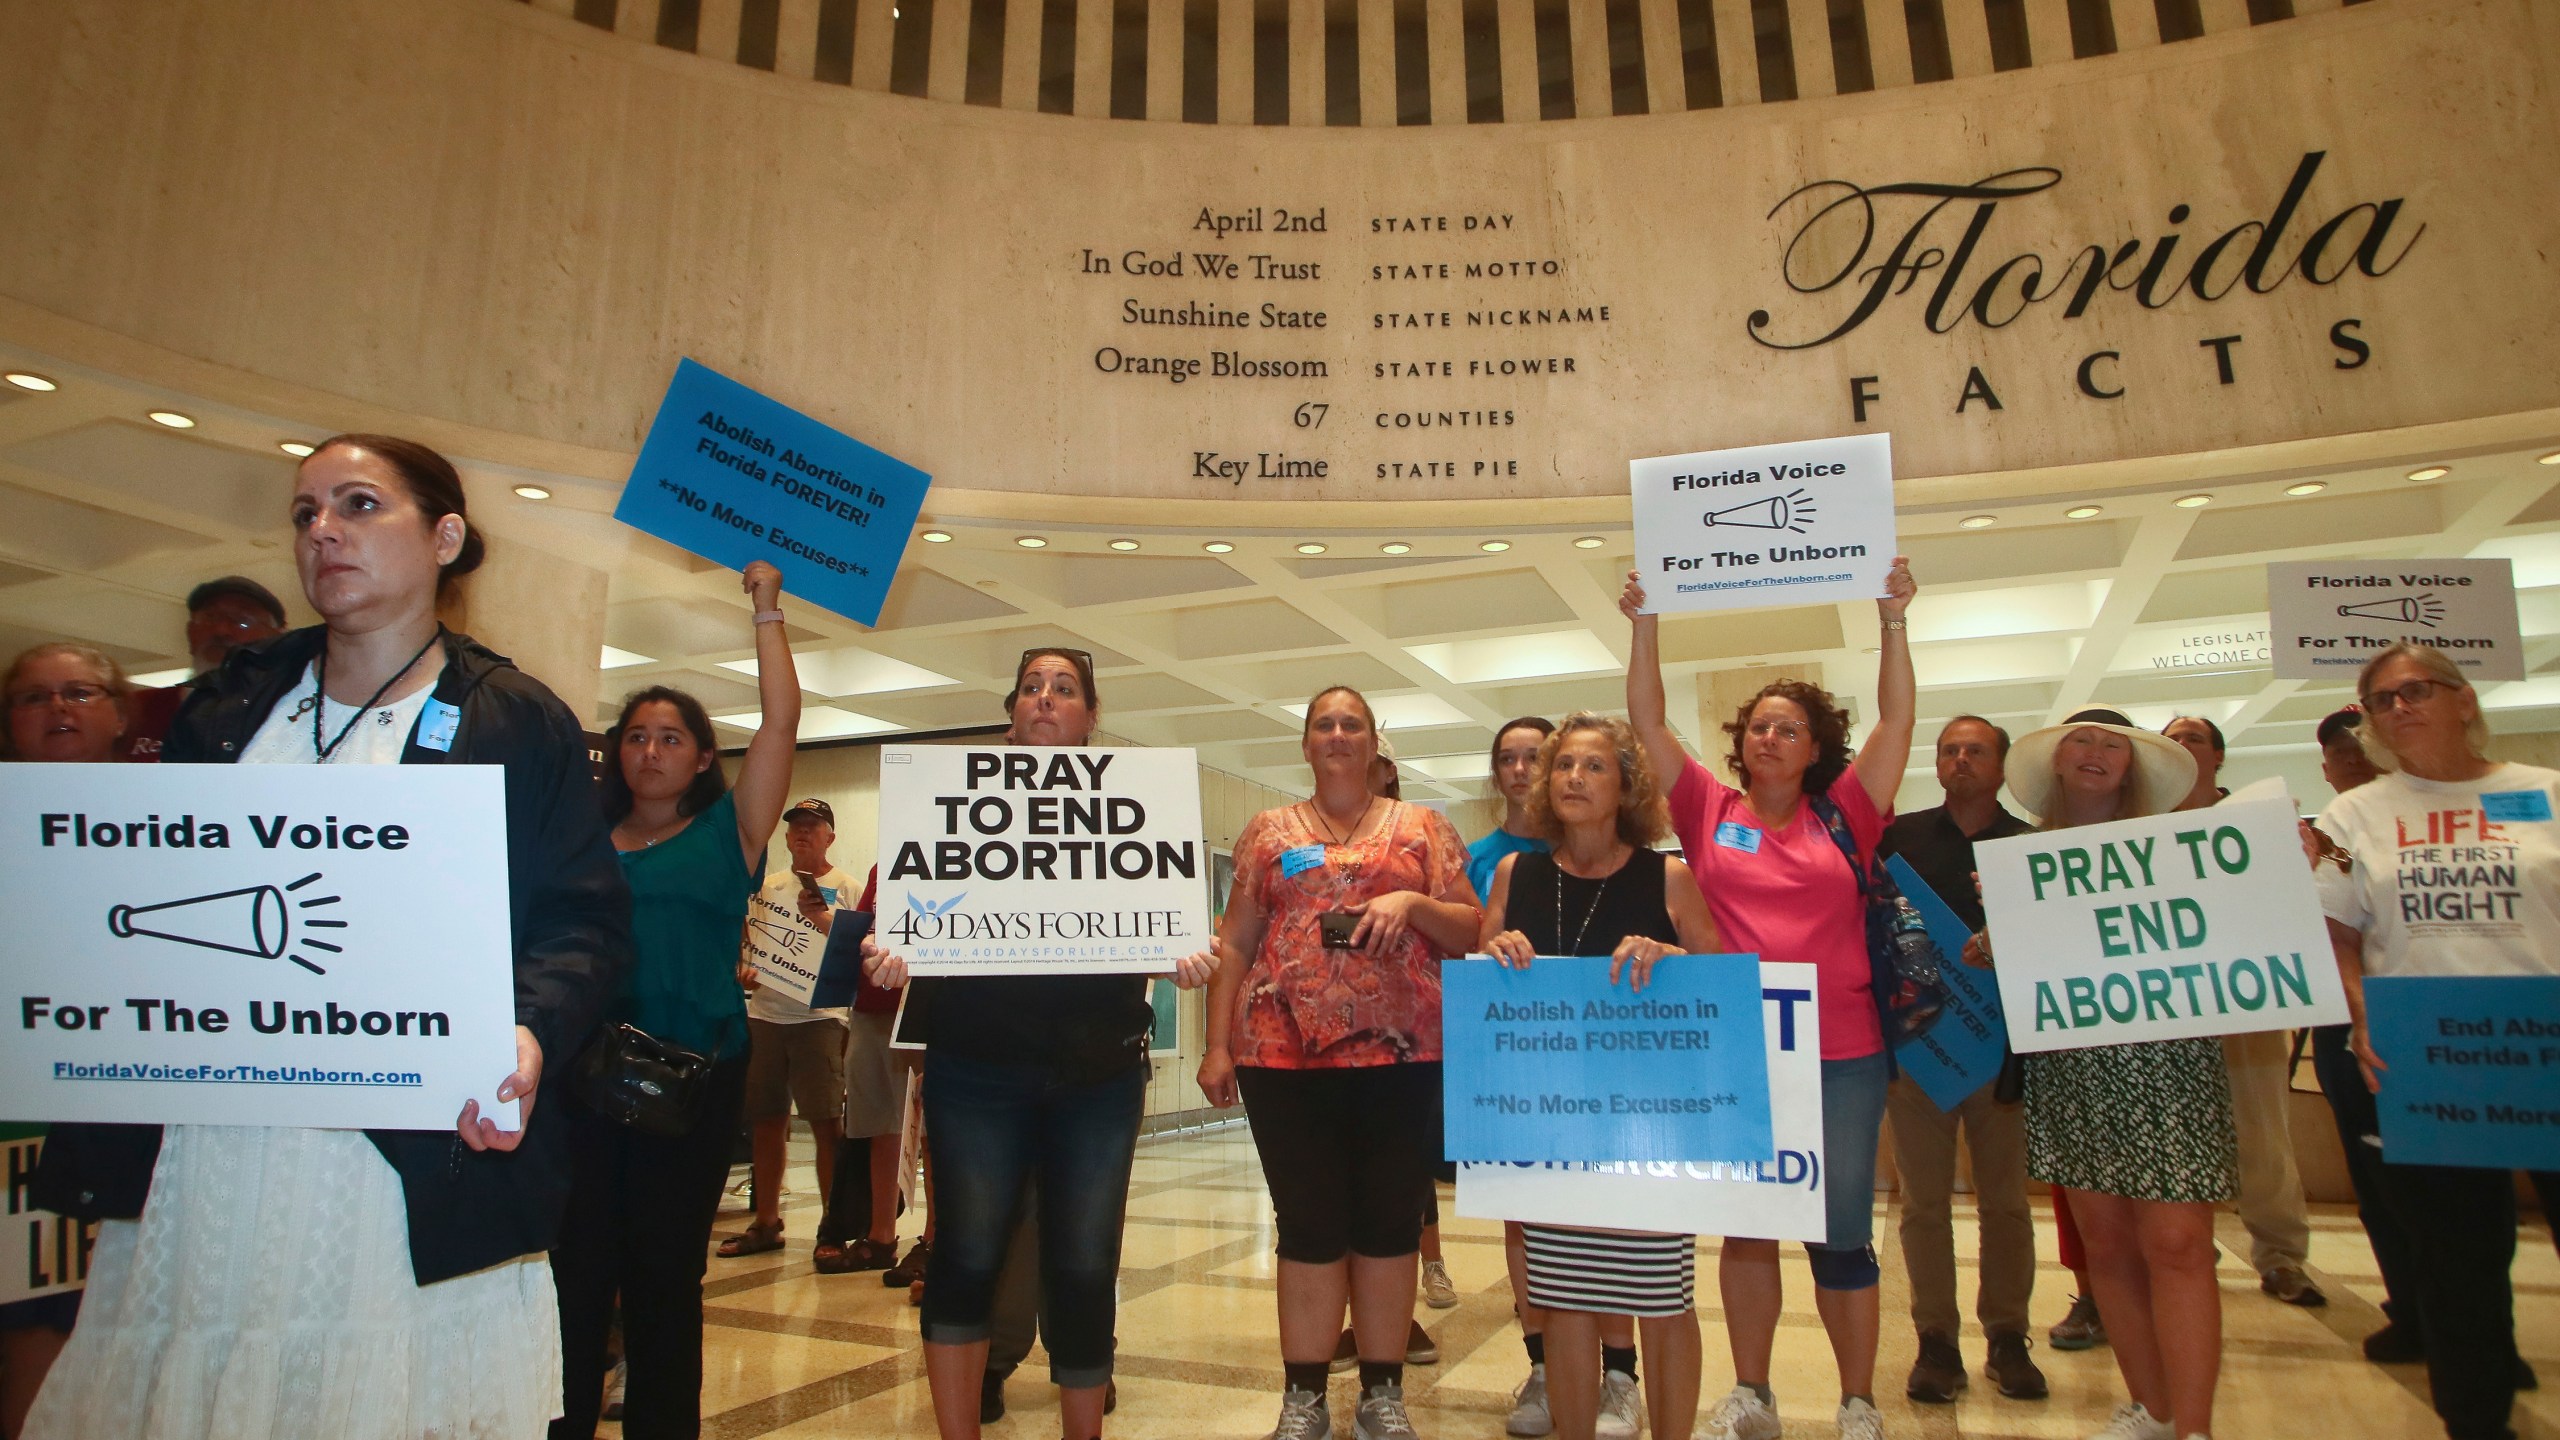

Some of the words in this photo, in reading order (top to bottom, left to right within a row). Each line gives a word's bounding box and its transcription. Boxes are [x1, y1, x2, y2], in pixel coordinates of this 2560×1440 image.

[1193, 207, 1264, 239] April
[1273, 207, 1327, 233] 2nd
[1372, 217, 1448, 232] STATE
[1465, 214, 1514, 230] DAY
[1747, 150, 2426, 349] Florida
[1082, 250, 1111, 274] In
[1121, 251, 1183, 277] God
[1193, 253, 1239, 280] We
[1248, 255, 1320, 281] Trust
[1373, 264, 1449, 280] STATE
[1466, 260, 1559, 277] MOTTO
[1122, 299, 1249, 328] Sunshine
[1260, 306, 1327, 328] State
[1374, 313, 1451, 328] STATE
[1468, 307, 1610, 326] NICKNAME
[1095, 348, 1200, 382] Orange
[1212, 352, 1328, 377] Blossom
[1375, 362, 1452, 378] STATE
[1470, 358, 1576, 376] FLOWER
[1850, 319, 2370, 422] FACTS
[1294, 402, 1328, 429] 67
[1376, 411, 1515, 427] COUNTIES
[698, 411, 775, 457] Abolish
[779, 450, 864, 499] Abortion
[867, 487, 885, 508] in
[1193, 452, 1248, 484] Key
[1258, 453, 1328, 478] Lime
[1377, 463, 1455, 478] STATE
[1474, 461, 1517, 476] PIE
[697, 437, 766, 482] Florida
[771, 473, 870, 528] FOREVER!
[1673, 470, 1761, 490] Florida
[1769, 463, 1846, 481] Voice
[711, 502, 764, 537] More
[1663, 556, 1703, 572] For
[1711, 552, 1760, 568] The
[1770, 544, 1866, 562] Unborn
[1677, 572, 1853, 592] FloridaVoiceForTheUnborn.com
[2307, 575, 2391, 588] Florida
[2401, 574, 2472, 587] Voice
[2183, 631, 2272, 647] LEGISLAT
[2299, 636, 2336, 648] For
[2345, 636, 2390, 648] The
[2152, 649, 2251, 668] WELCOME
[967, 753, 1114, 791] PRAY
[935, 796, 1013, 835] TO
[1028, 797, 1146, 835] END
[2396, 810, 2512, 848] LIFE
[41, 813, 230, 849] Florida
[248, 815, 410, 850] Voice
[888, 840, 1196, 881] ABORTION
[2026, 837, 2155, 900] PRAY
[2175, 825, 2250, 879] TO
[2397, 849, 2441, 864] THE
[2452, 846, 2519, 862] FIRST
[2397, 865, 2515, 888] HUMAN
[2400, 892, 2521, 922] RIGHT
[888, 908, 943, 945] 40
[947, 912, 1031, 940] DAYS
[2093, 897, 2207, 957] END
[917, 946, 1164, 957] WWW.40DAYSFORLIFE.COM
[2034, 953, 2314, 1032] ABORTION
[21, 997, 109, 1030] For
[126, 999, 229, 1033] The
[249, 1000, 451, 1037] Unborn
[1484, 1002, 1575, 1022] Abolish
[1582, 1000, 1688, 1020] Abortion
[1696, 999, 1718, 1019] in
[1982, 1002, 1998, 1020] in
[2438, 1018, 2494, 1036] End
[1495, 1032, 1577, 1052] Florida
[1585, 1031, 1710, 1051] FOREVER!
[2426, 1045, 2531, 1065] Florida
[53, 1062, 423, 1086] FloridaVoiceForTheUnborn.com
[1540, 1096, 1601, 1114] More
